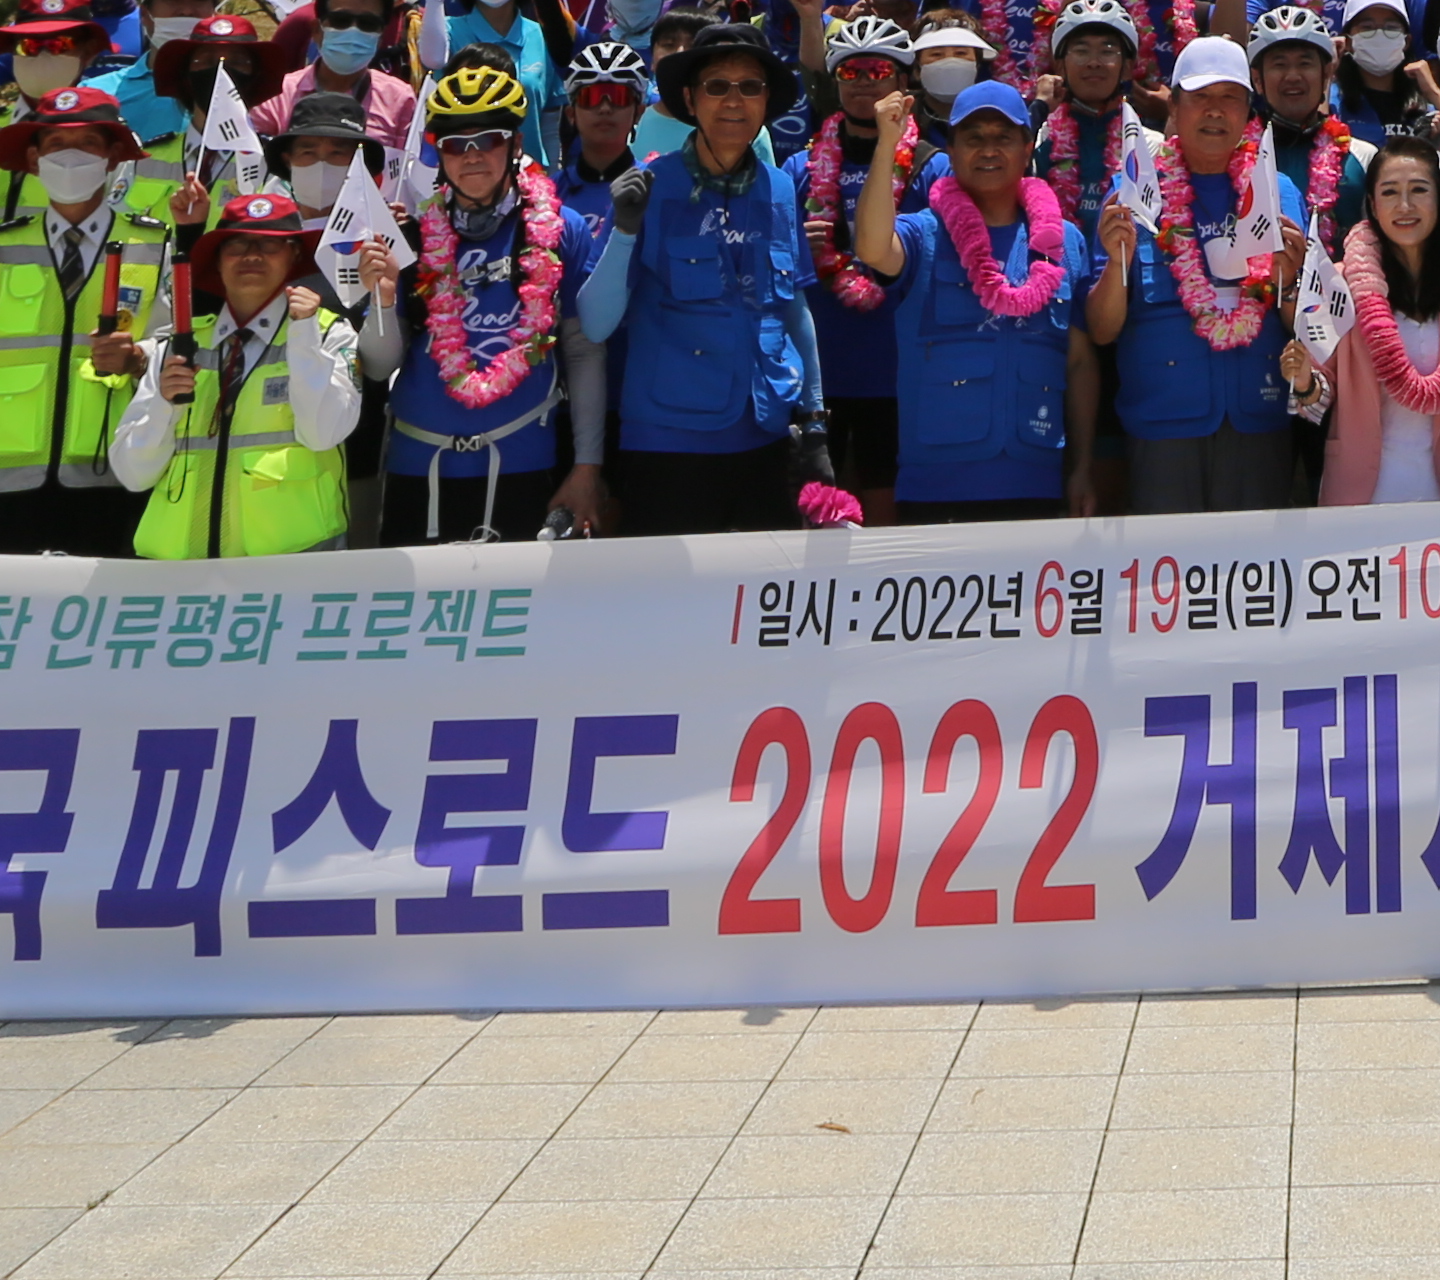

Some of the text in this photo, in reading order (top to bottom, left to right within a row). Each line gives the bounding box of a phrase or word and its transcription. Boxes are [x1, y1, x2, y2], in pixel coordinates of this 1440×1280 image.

[45, 591, 284, 671] 인류평화
[296, 587, 532, 663] 프로젝트
[95, 713, 680, 959] 피스로드
[716, 693, 1101, 937] 2022
